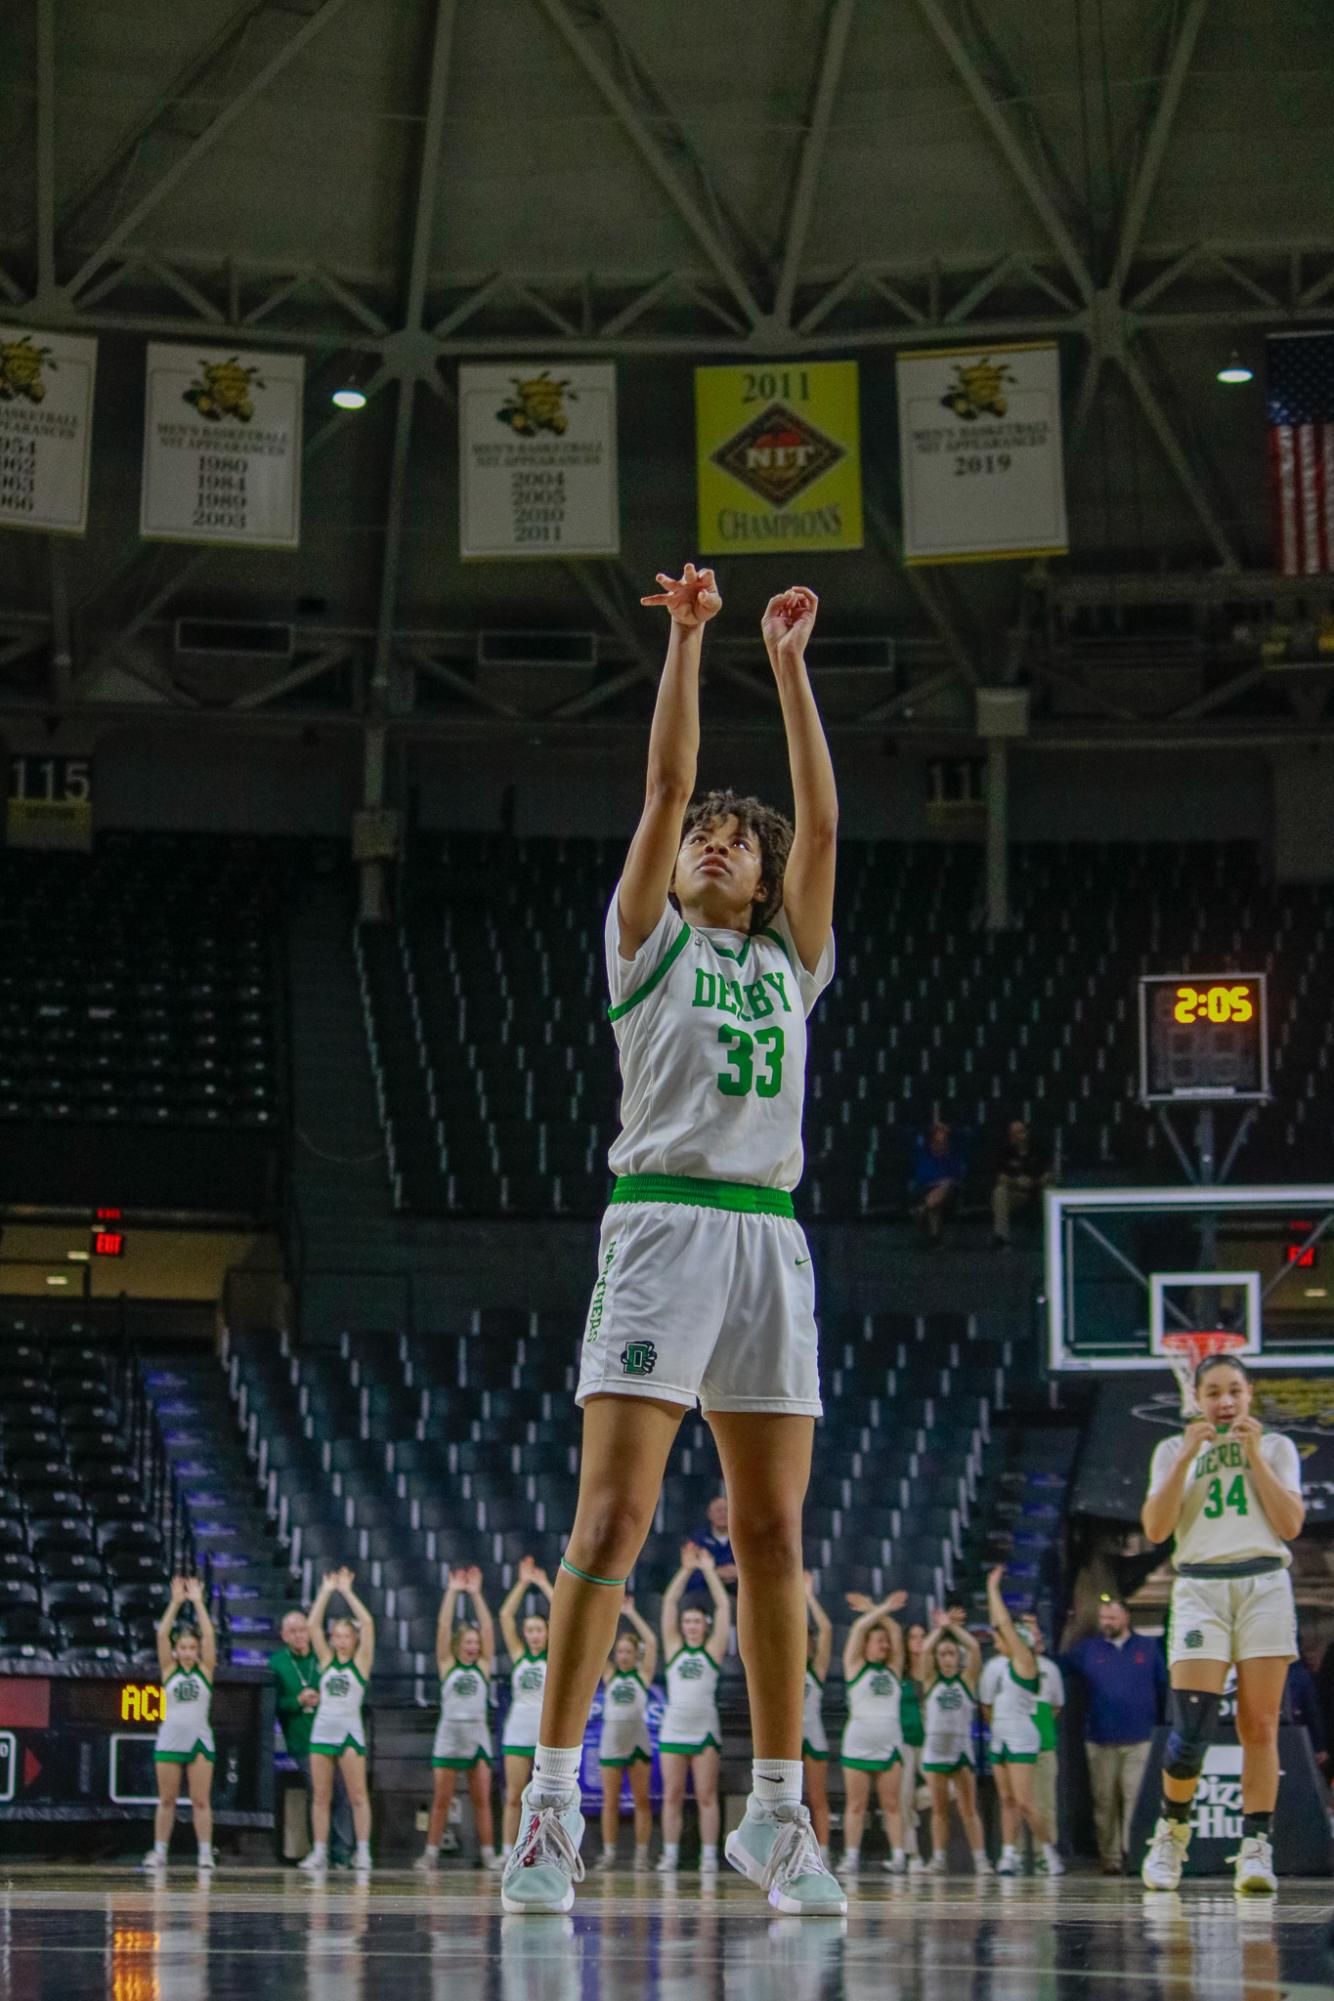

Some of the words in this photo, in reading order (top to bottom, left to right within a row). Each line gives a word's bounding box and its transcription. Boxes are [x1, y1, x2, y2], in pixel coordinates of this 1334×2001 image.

[742, 372, 810, 403] 2011
[0, 437, 36, 455] 954
[745, 446, 815, 469] NIT
[0, 457, 36, 475] 962
[954, 454, 1012, 476] 2019
[0, 476, 35, 492] 963
[514, 525, 561, 542] 2011
[717, 503, 843, 540] CHAMPIONS
[12, 760, 90, 802] 115
[929, 762, 973, 802] 11
[1174, 986, 1252, 1023] 2:05
[717, 1023, 784, 1098] 33
[1204, 1474, 1248, 1519] 34
[1190, 1776, 1243, 1810] Piz
[1188, 1805, 1245, 1838] Hu
